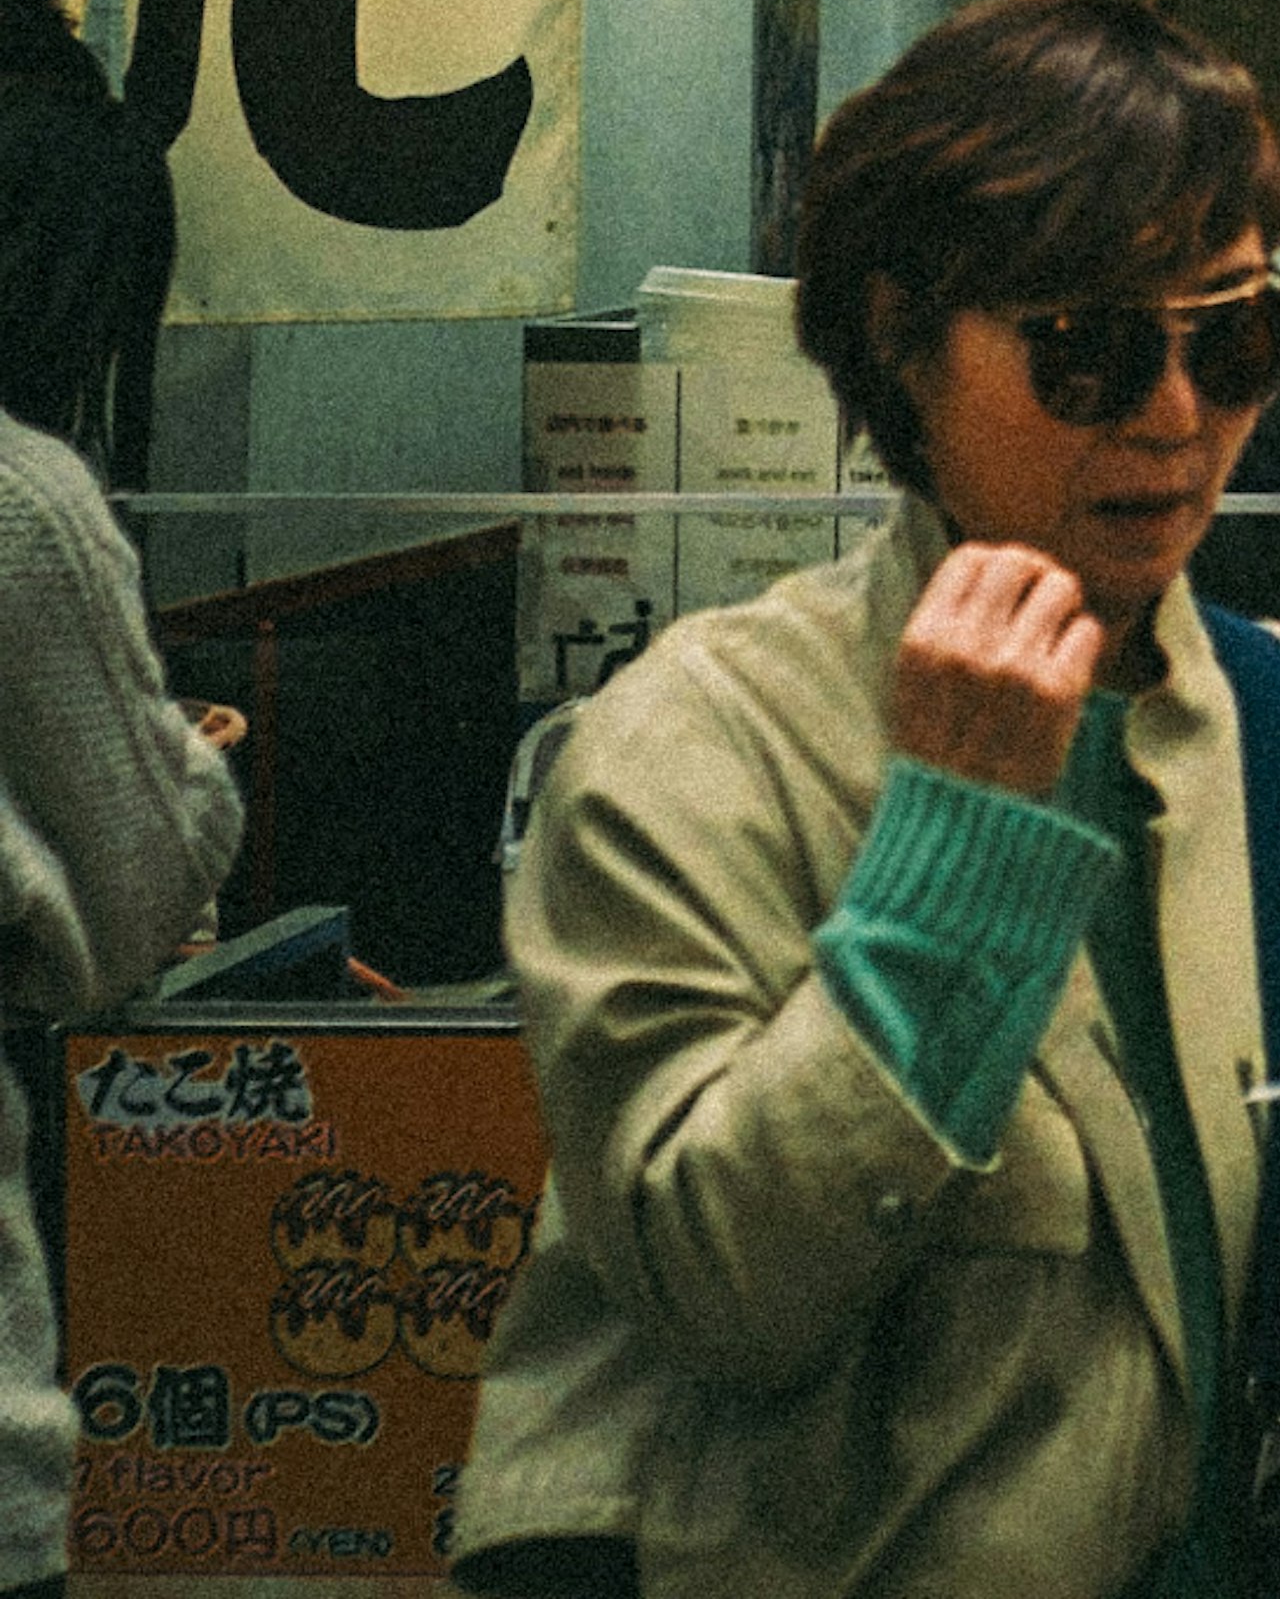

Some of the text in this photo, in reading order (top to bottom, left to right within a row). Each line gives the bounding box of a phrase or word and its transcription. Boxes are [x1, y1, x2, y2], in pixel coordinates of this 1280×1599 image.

[86, 1042, 310, 1123] たこ焼
[95, 1123, 337, 1161] TAKOYAKI
